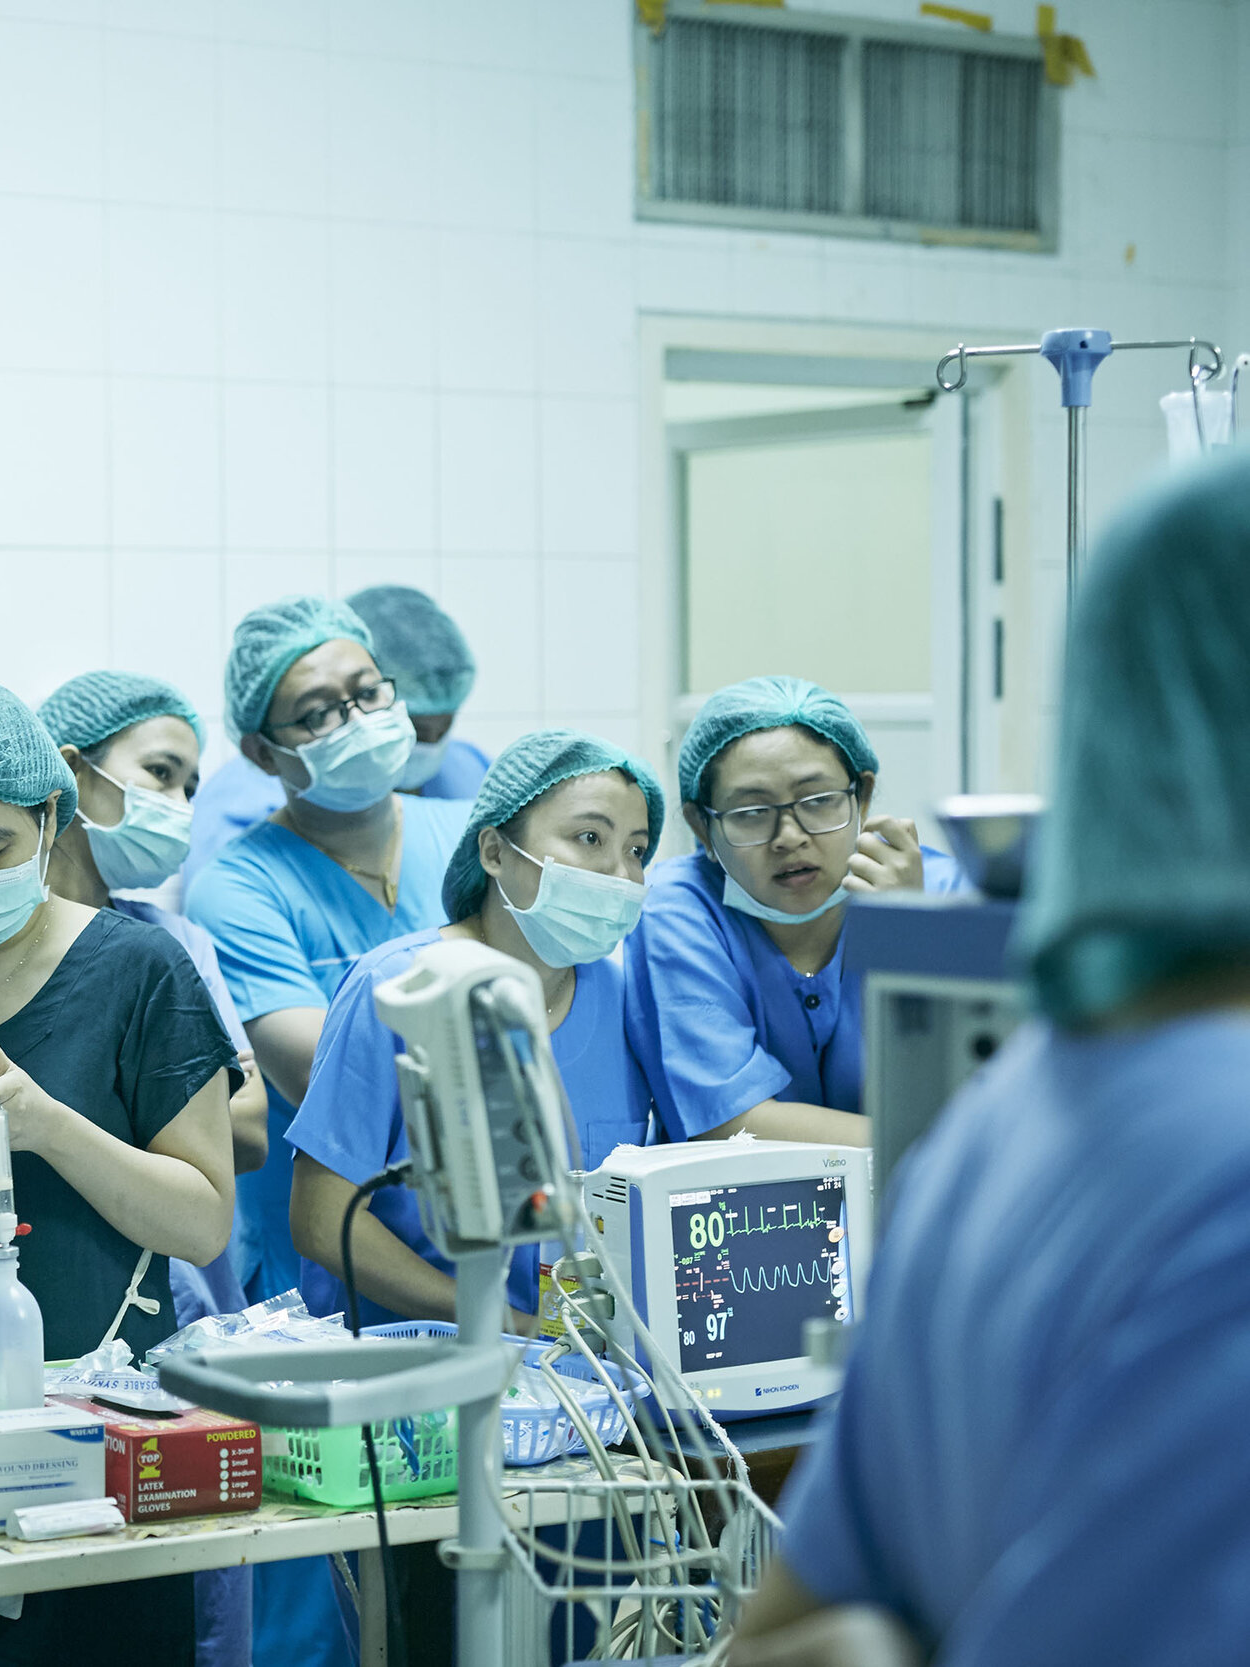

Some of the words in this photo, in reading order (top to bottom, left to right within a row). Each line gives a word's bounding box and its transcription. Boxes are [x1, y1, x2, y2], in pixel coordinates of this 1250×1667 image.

[822, 1159, 847, 1168] Vismo
[690, 1211, 725, 1250] 80
[706, 1312, 728, 1342] 97
[683, 1330, 696, 1346] 80
[206, 1429, 256, 1443] POWDERED
[141, 1453, 160, 1464] TOP
[231, 1459, 249, 1467] Small
[32, 1460, 79, 1472] DRESSING
[138, 1482, 164, 1492] LATEX
[231, 1481, 249, 1489] Large
[138, 1489, 197, 1503] EXAMINATION
[138, 1503, 171, 1513] GLOVES
